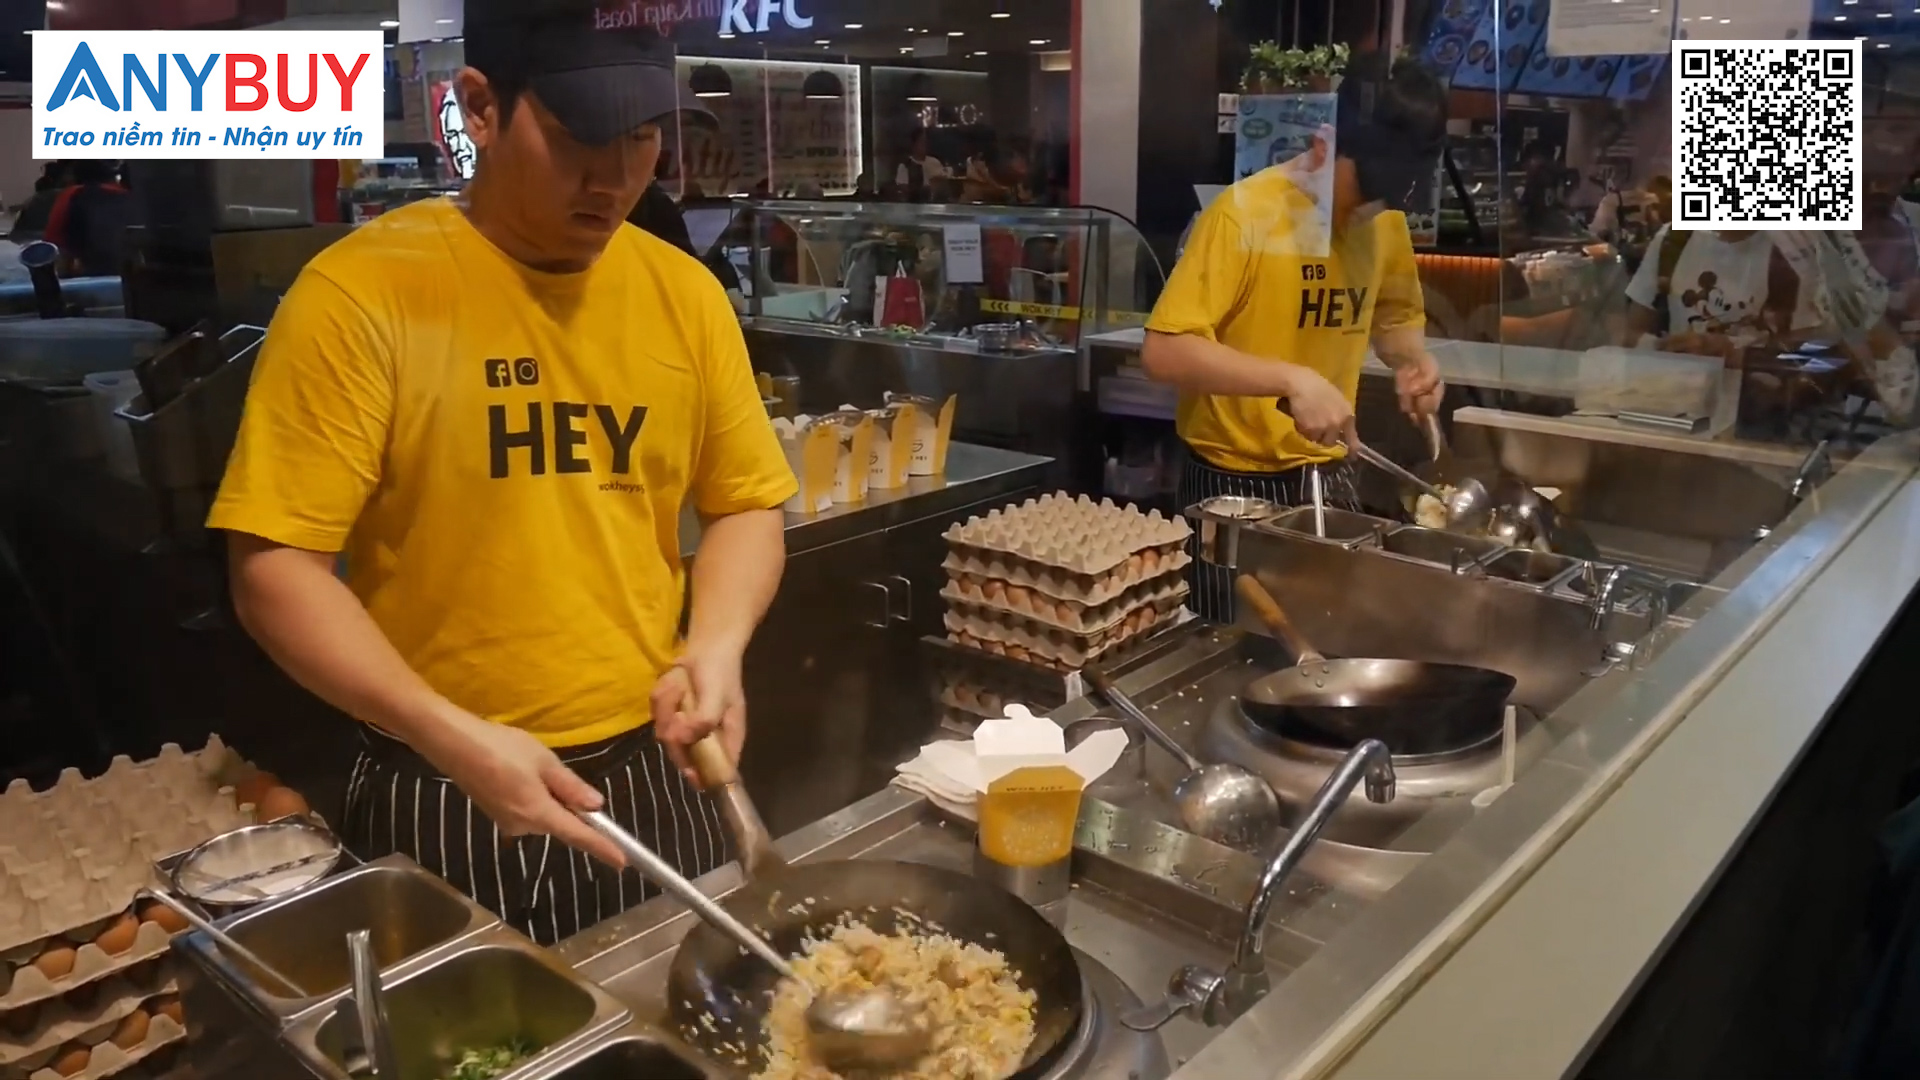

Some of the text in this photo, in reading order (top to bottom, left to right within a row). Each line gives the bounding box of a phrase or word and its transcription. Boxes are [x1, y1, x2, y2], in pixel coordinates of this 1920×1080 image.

[717, 0, 814, 34] KFC
[1298, 287, 1368, 329] HEY
[488, 402, 648, 478] HEY
